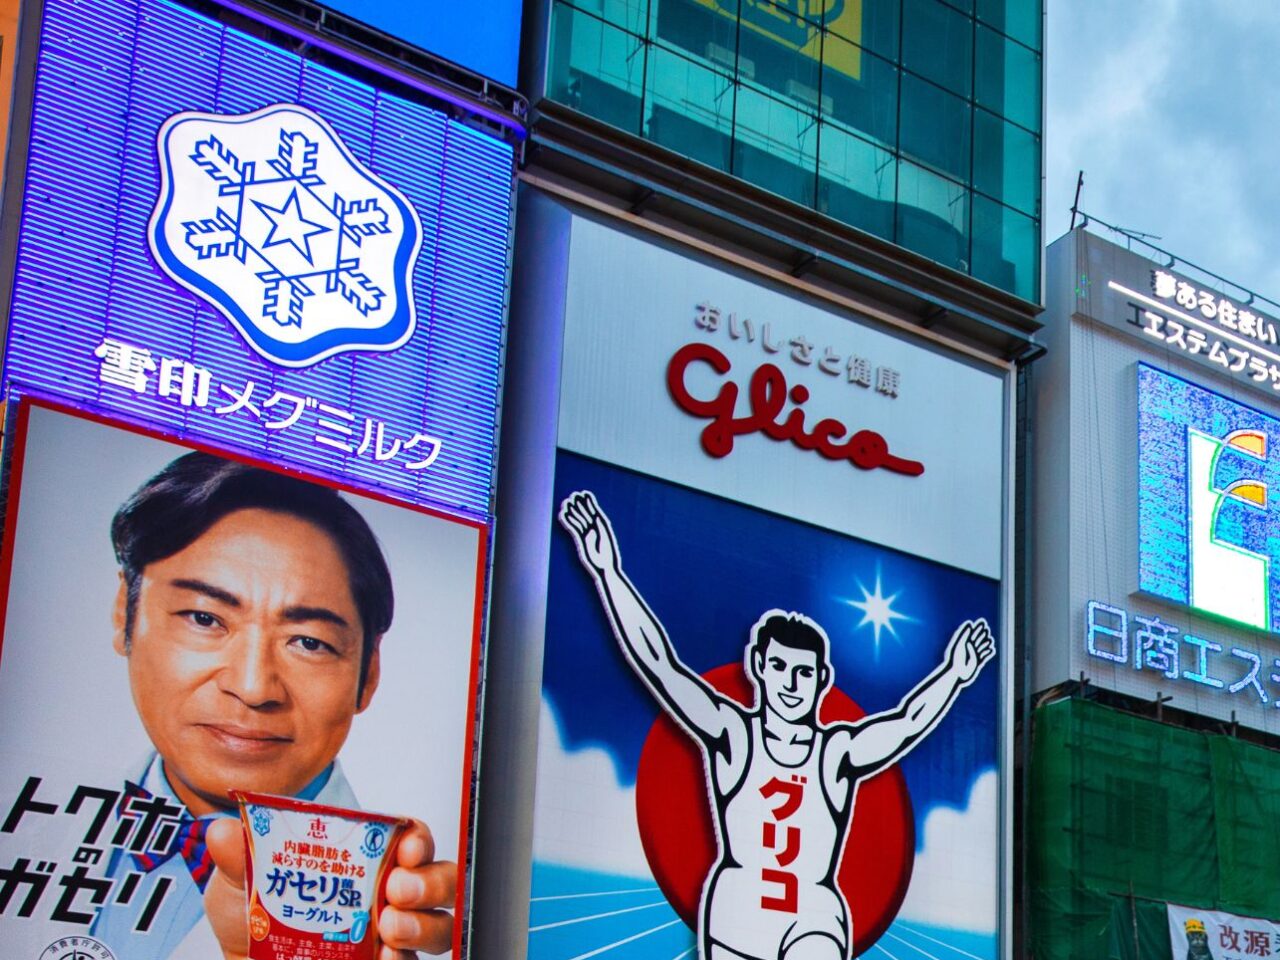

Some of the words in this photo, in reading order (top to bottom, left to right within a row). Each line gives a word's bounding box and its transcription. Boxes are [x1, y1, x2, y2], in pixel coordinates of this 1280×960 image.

[695, 302, 901, 399] おいしさと健康
[95, 338, 442, 471] 雪印メグミルク
[666, 342, 925, 476] Glico
[1, 775, 184, 853] トクホ
[306, 817, 328, 839] 恵
[73, 846, 104, 865] の
[271, 851, 366, 878] 減らすのを助ける
[284, 840, 352, 863] 内臓脂肪を
[0, 858, 173, 933] ガセリ
[282, 904, 343, 925] ヨーグルト
